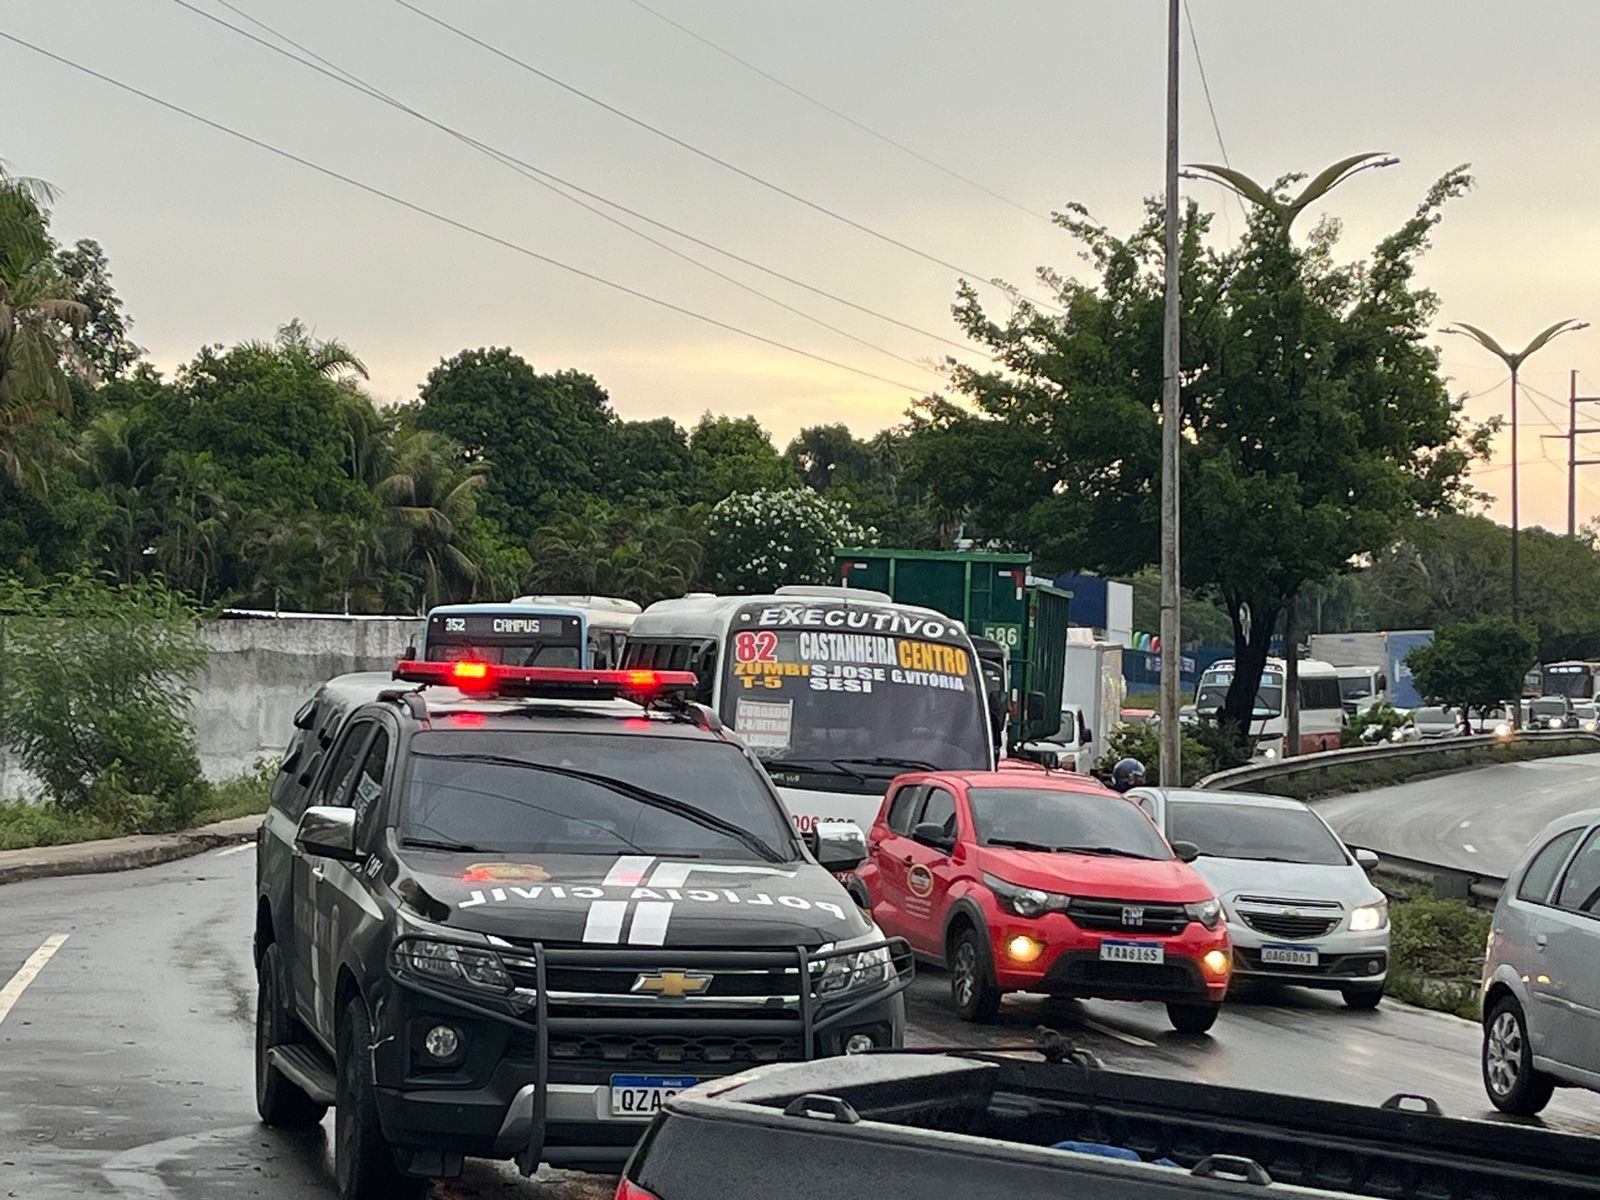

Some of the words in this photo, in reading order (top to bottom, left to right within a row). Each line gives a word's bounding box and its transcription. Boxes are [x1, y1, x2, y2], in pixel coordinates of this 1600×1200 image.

[445, 617, 465, 631] 352
[493, 618, 540, 633] CAMPUS
[759, 608, 945, 638] EXECUTIVO
[985, 627, 1017, 645] 586
[735, 631, 777, 663] 82
[799, 632, 898, 666] CASTANHEIRA
[898, 639, 969, 677] CENTRO
[734, 663, 809, 677] ZUMBI
[811, 664, 886, 682] S.JOSE
[891, 669, 965, 692] G.VITORIA
[739, 676, 782, 689] T-5
[809, 677, 872, 693] SESI
[621, 1089, 676, 1112] QZA
